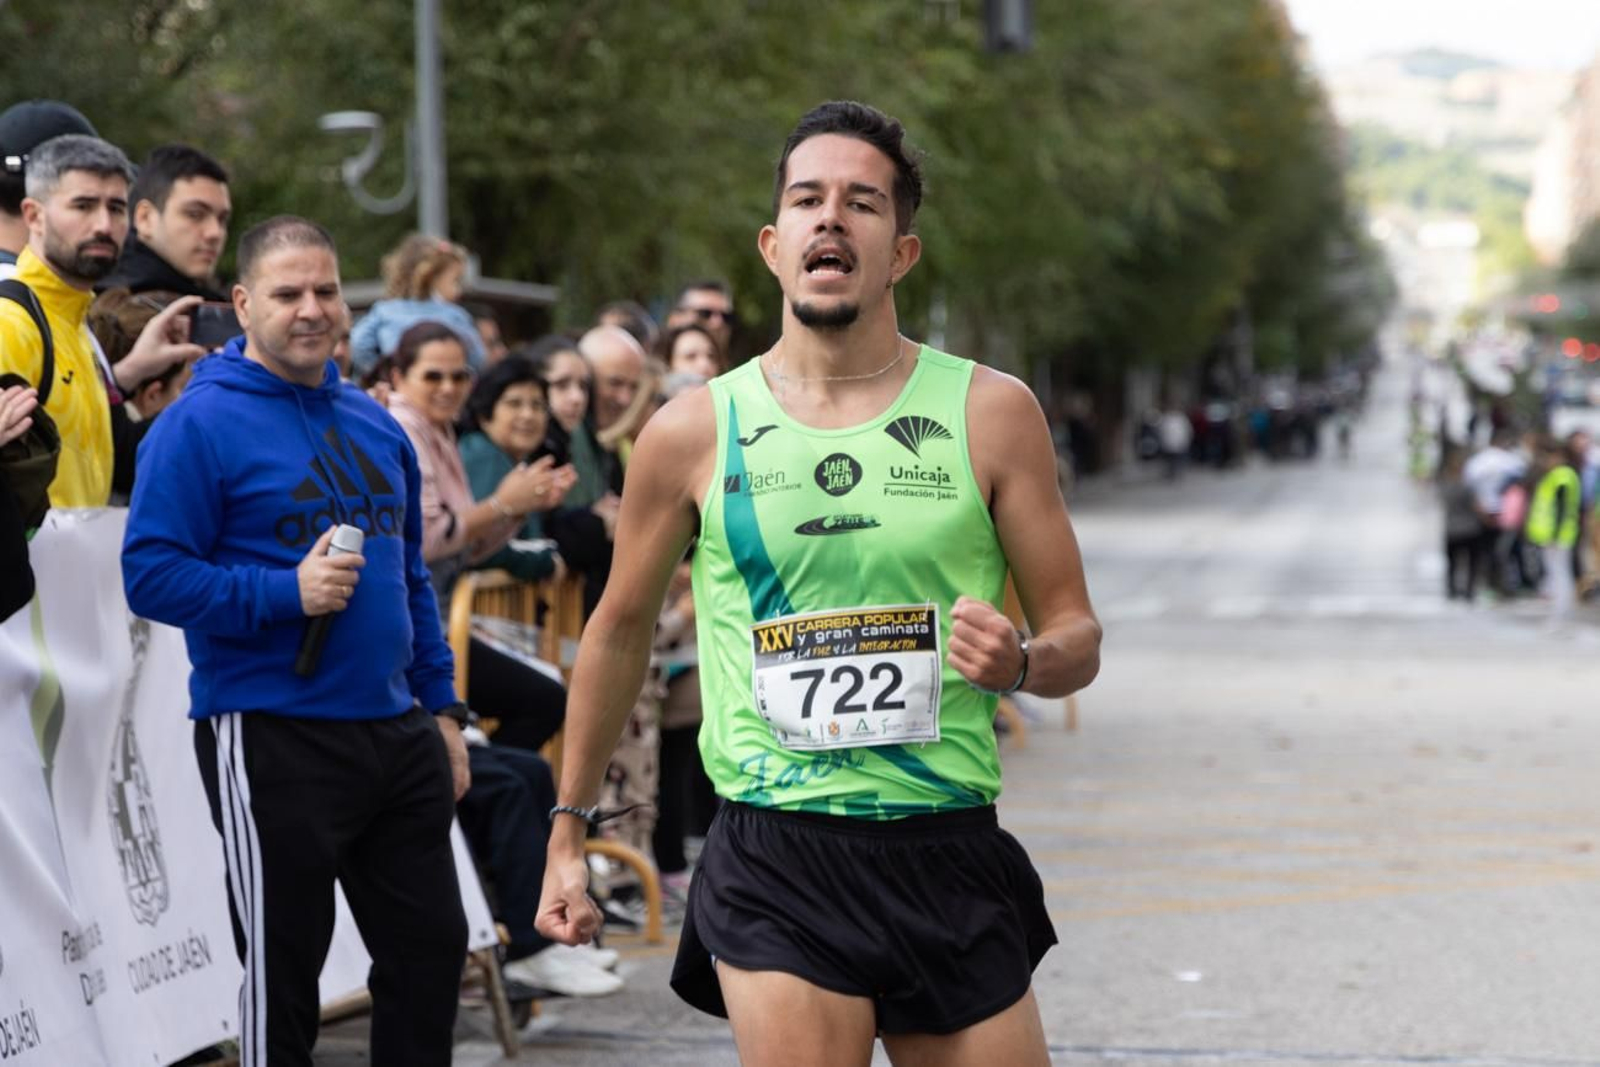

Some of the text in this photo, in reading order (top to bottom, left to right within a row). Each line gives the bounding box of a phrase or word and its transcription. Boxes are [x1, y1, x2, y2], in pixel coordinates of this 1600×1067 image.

[744, 468, 785, 491] Jaén
[890, 465, 951, 485] Unicaja
[884, 487, 958, 501] Fundación Jaén
[797, 613, 928, 633] CARRERA POPULAR
[758, 624, 794, 654] XXV
[797, 623, 929, 646] y gran caminata
[797, 649, 811, 660] LA
[842, 643, 857, 654] LA
[790, 662, 906, 719] 722
